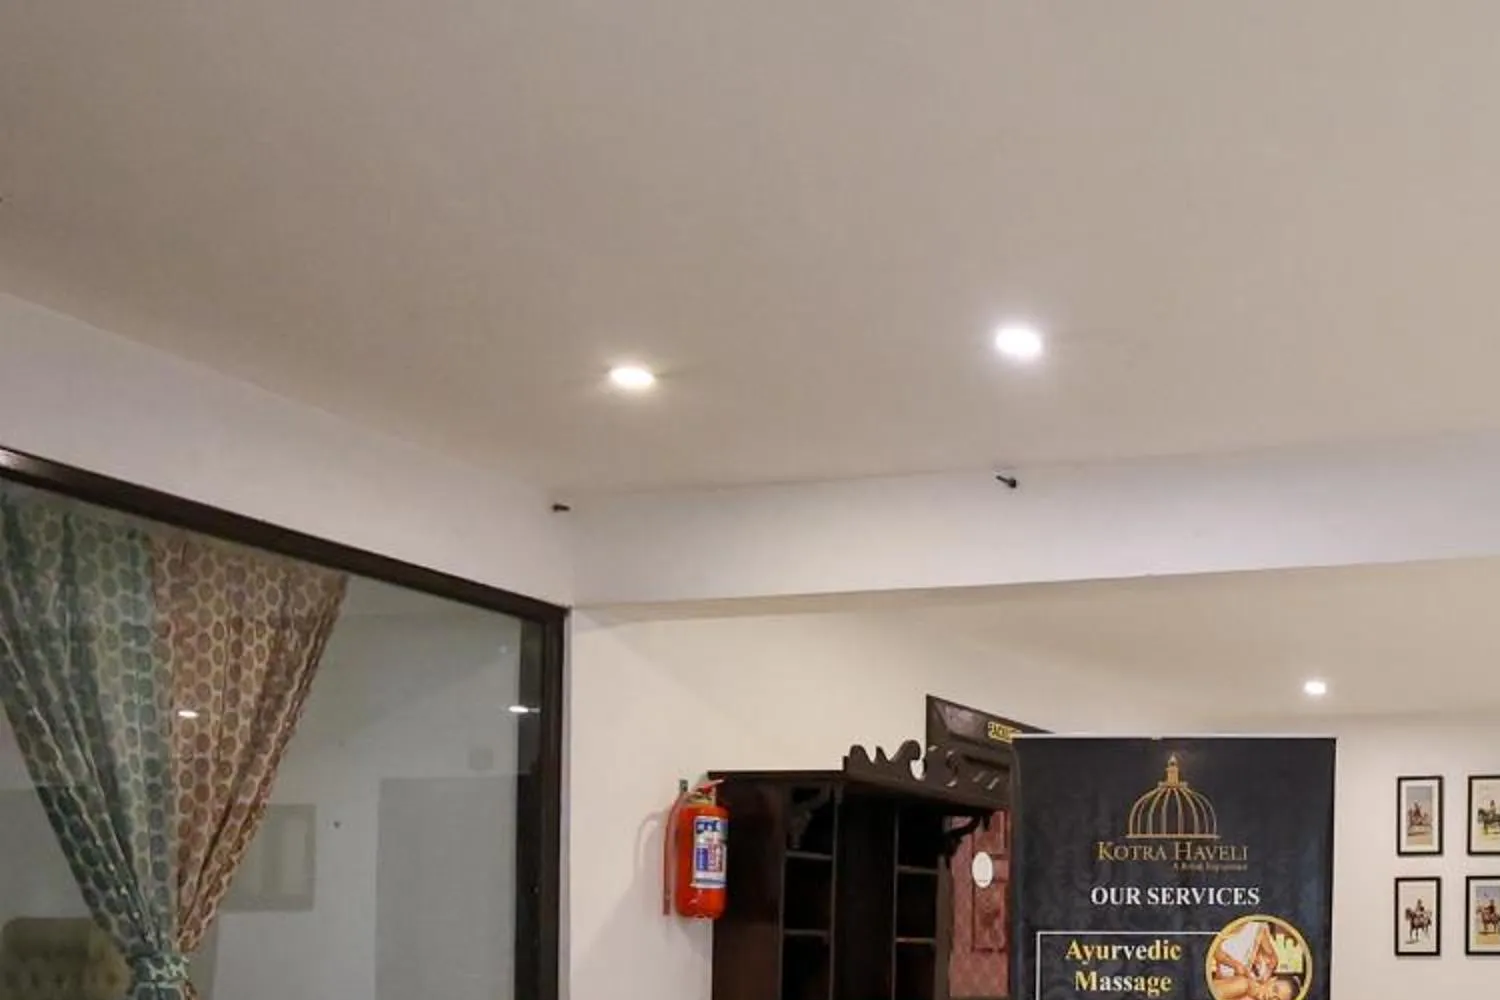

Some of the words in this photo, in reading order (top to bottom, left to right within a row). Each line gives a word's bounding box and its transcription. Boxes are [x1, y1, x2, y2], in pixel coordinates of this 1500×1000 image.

[1091, 887, 1141, 905] OUR
[1147, 886, 1260, 905] SERVICES
[1065, 940, 1182, 965] Ayurvedic
[1074, 971, 1172, 997] Massage
